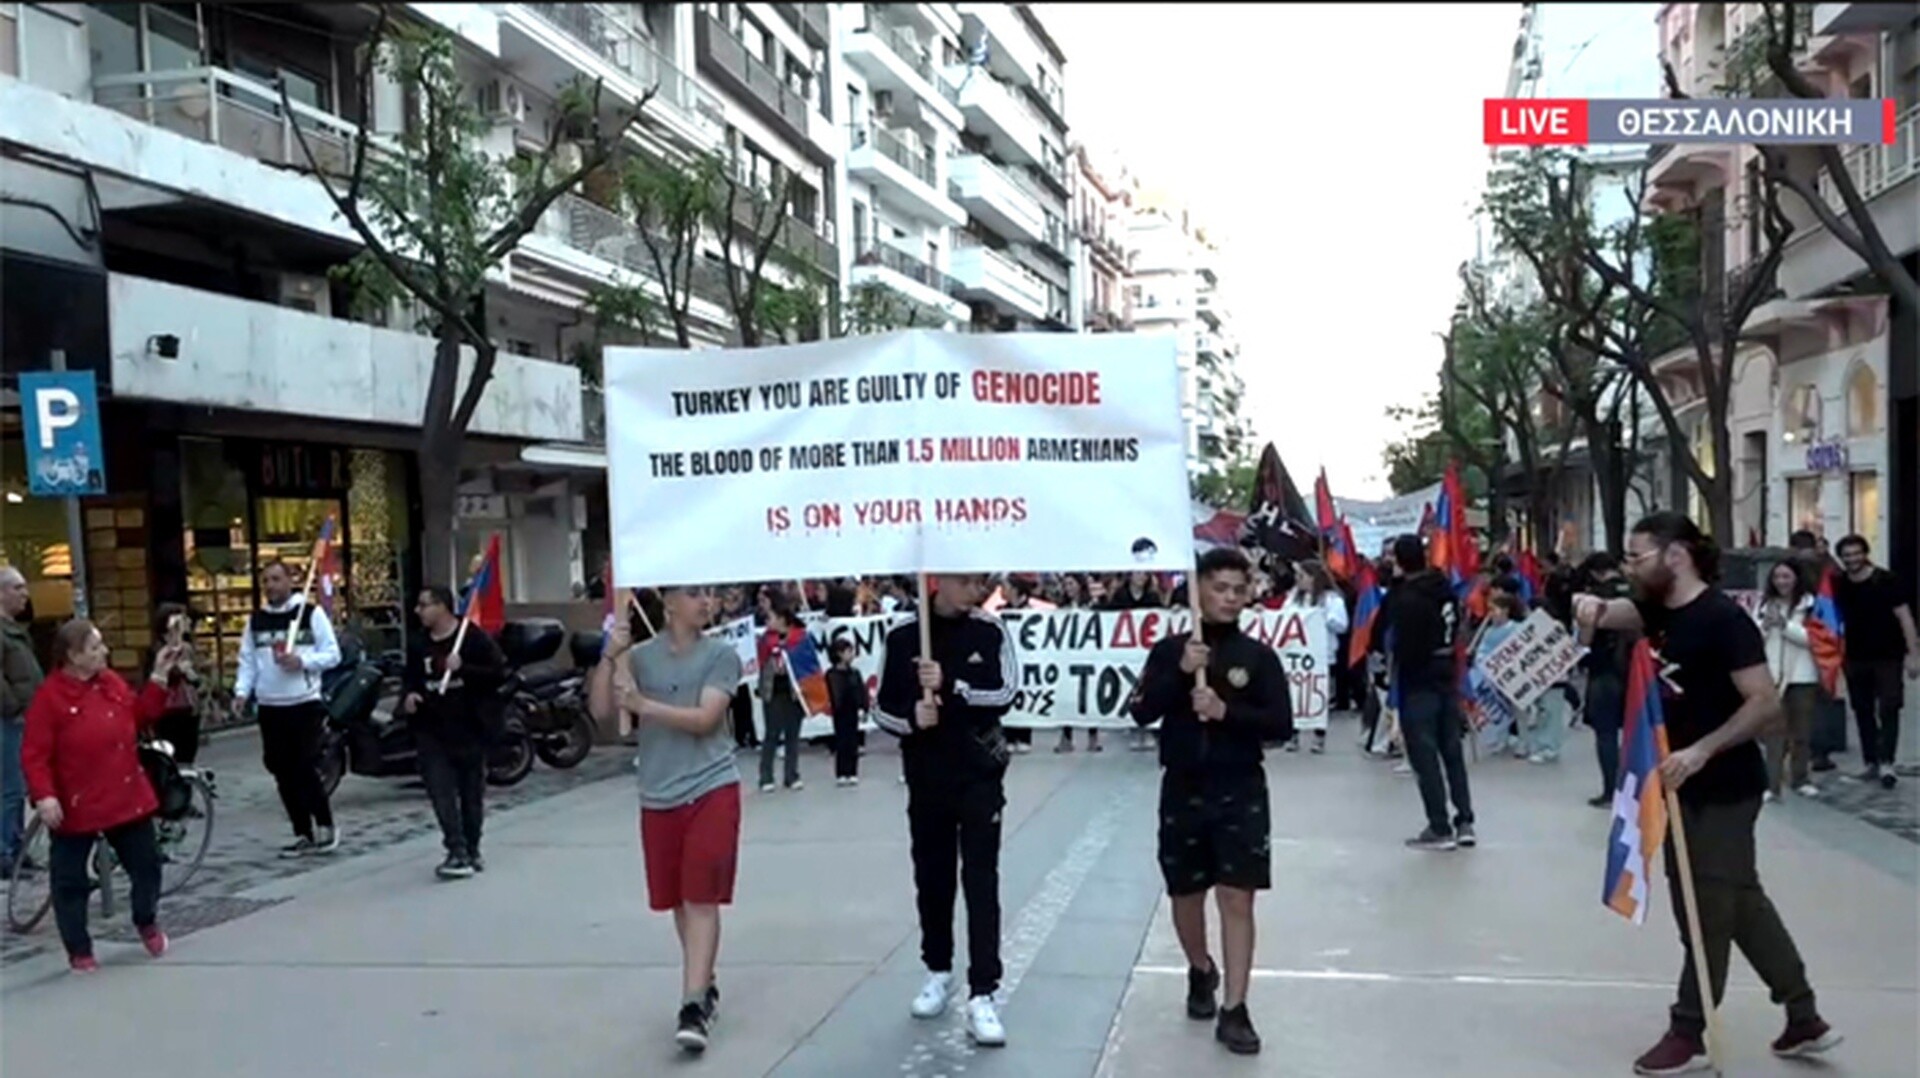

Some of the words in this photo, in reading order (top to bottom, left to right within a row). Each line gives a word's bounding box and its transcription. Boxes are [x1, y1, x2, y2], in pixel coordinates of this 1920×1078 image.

[671, 387, 752, 417] TURKEY
[759, 381, 801, 410] YOU
[808, 378, 849, 407] ARE
[857, 373, 927, 403] GUILTY
[935, 372, 961, 399] OF
[972, 370, 1101, 405] GENOCIDE
[36, 388, 80, 449] P
[261, 444, 344, 488] BUTLR
[649, 452, 685, 478] THE
[691, 449, 753, 476] BLOOD
[759, 447, 783, 472] OF
[789, 442, 846, 469] MORE
[851, 438, 899, 466] THAN
[906, 437, 933, 462] 1.5
[940, 436, 1021, 462] MILLION
[1027, 437, 1139, 462] ARMENIANS
[766, 506, 790, 532] IS
[804, 503, 841, 529] ON
[854, 498, 922, 526] YOUR
[935, 497, 1027, 524] HANDS
[1286, 653, 1315, 671] ΤΟ
